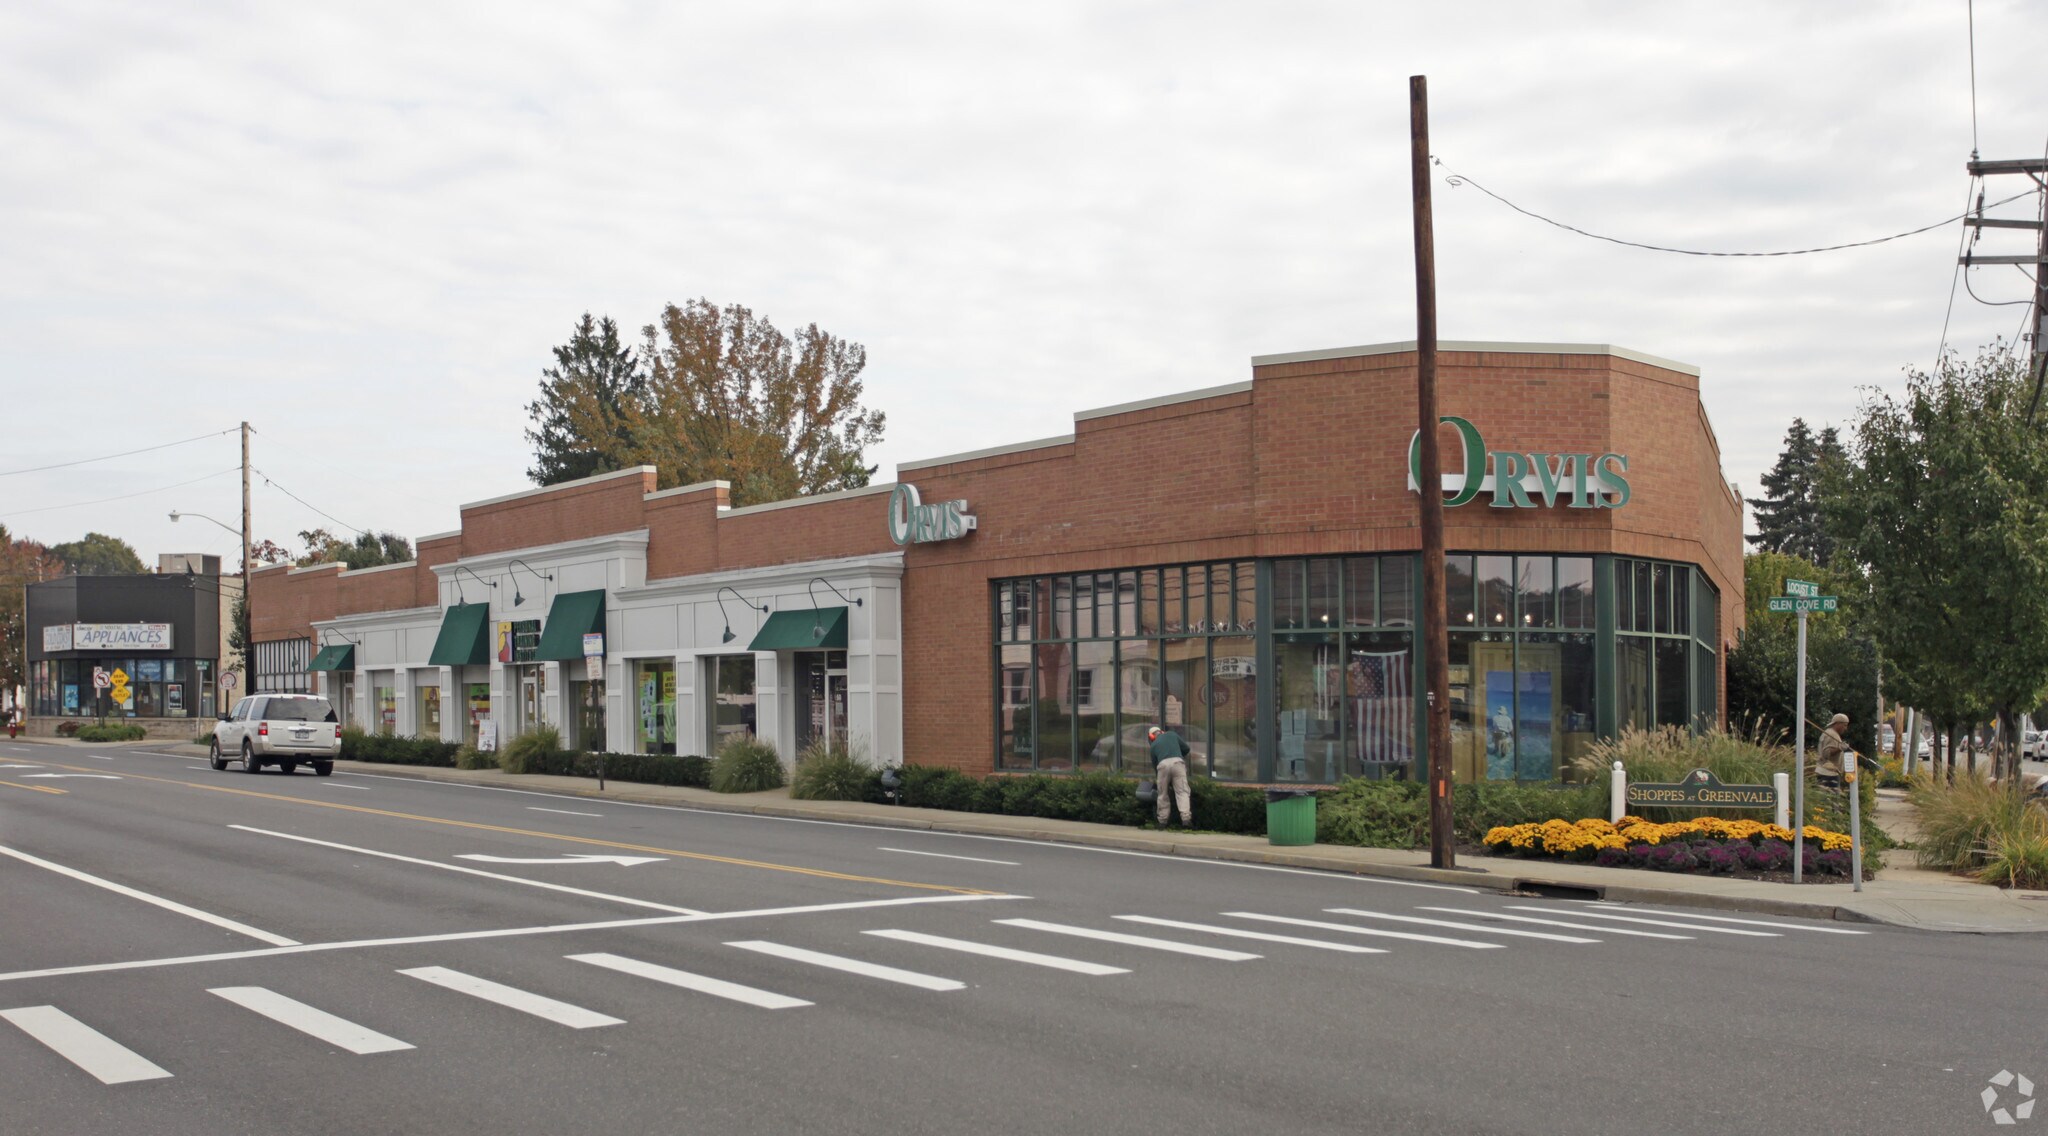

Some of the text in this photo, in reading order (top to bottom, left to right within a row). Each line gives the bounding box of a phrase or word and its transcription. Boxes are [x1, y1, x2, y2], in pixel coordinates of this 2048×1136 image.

[1408, 416, 1631, 508] ORVIS
[889, 483, 967, 545] ORVIS
[1787, 582, 1819, 596] LOCUST ST
[1769, 599, 1836, 610] GLEN COVE RD
[82, 630, 163, 643] APPLIANCES
[1629, 787, 1685, 801] SHOPPES
[1698, 788, 1773, 803] GREENVALE
